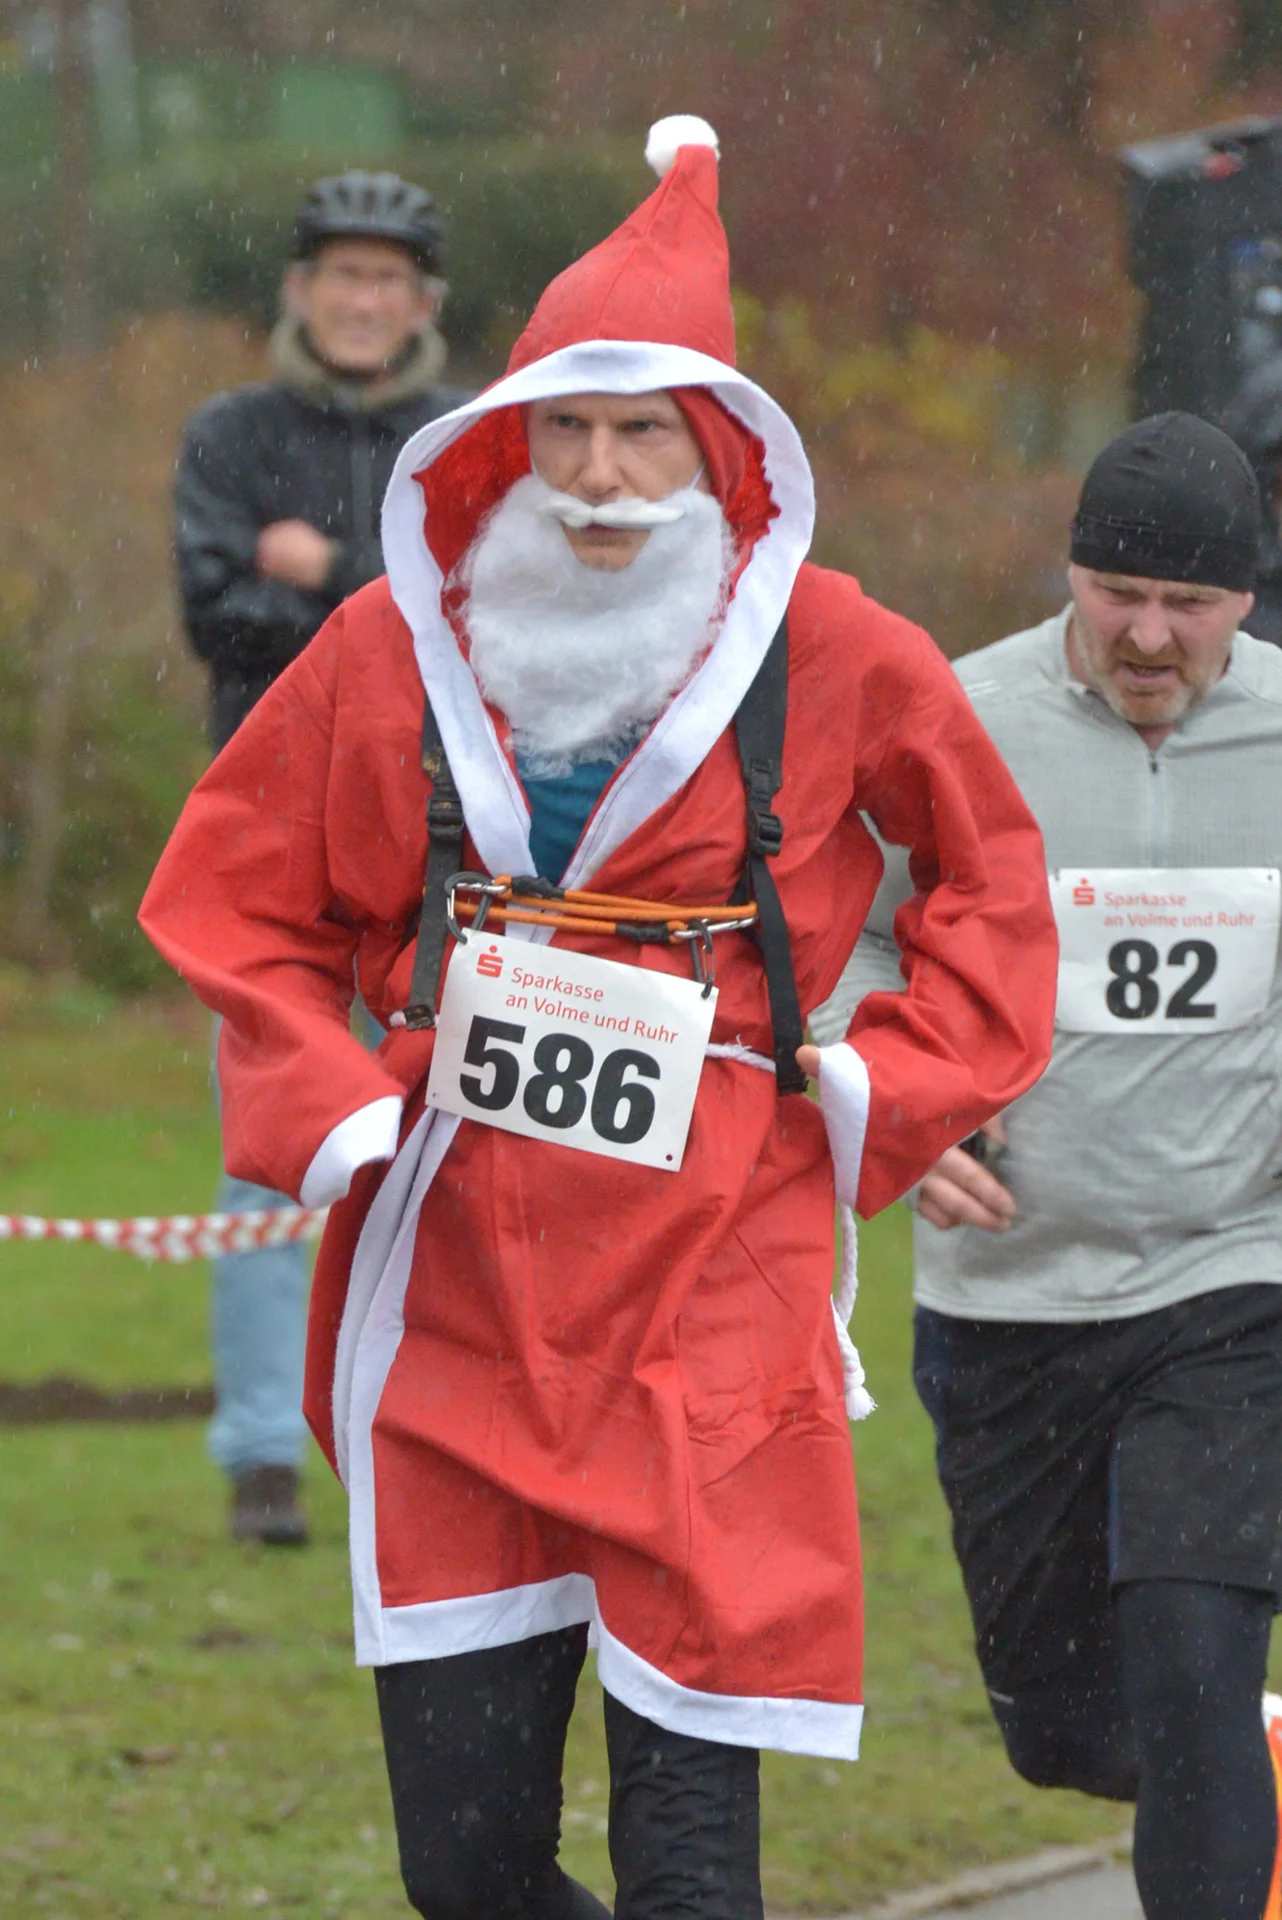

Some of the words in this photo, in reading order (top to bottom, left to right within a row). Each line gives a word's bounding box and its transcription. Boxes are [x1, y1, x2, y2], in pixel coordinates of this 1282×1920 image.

[1104, 892, 1187, 908] Sparkasse
[1104, 914, 1124, 927] an
[1127, 912, 1178, 927] Volme
[1182, 912, 1213, 927] und
[1218, 912, 1255, 927] Ruhr
[511, 967, 604, 1002] Sparkasse
[1105, 938, 1218, 1020] 82
[505, 994, 528, 1009] an
[534, 996, 590, 1022] Volme
[595, 1015, 629, 1032] und
[633, 1019, 678, 1044] Ruhr
[459, 1014, 661, 1144] 586
